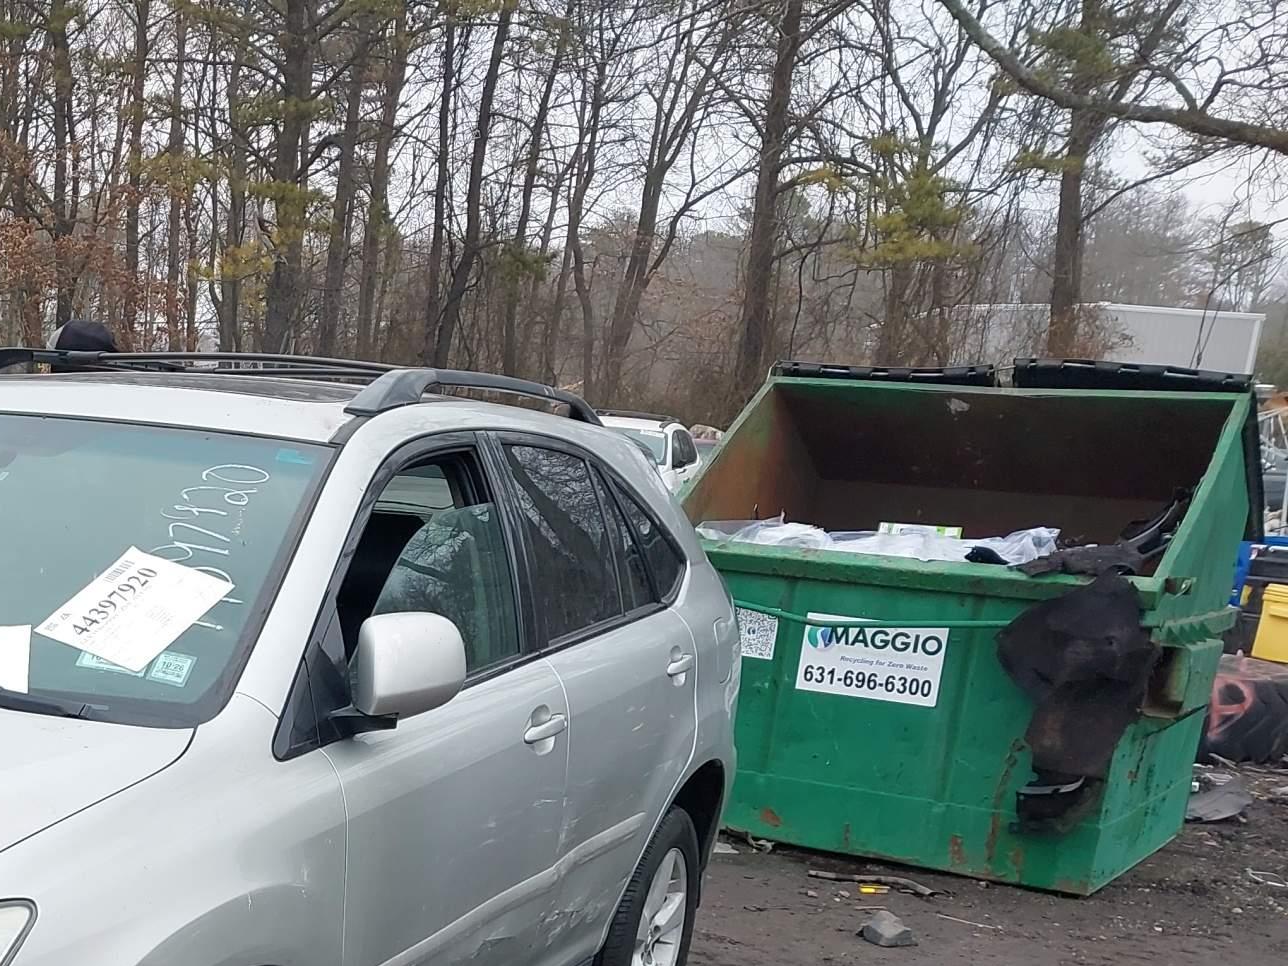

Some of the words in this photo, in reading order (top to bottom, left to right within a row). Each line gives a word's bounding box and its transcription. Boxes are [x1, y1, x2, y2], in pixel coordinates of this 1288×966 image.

[71, 566, 158, 637] 44397920
[827, 626, 943, 656] MAGGIO
[840, 655, 874, 666] Recycling
[887, 660, 904, 669] Zero
[905, 663, 929, 672] Waste
[803, 664, 932, 698] 631-696-6300
